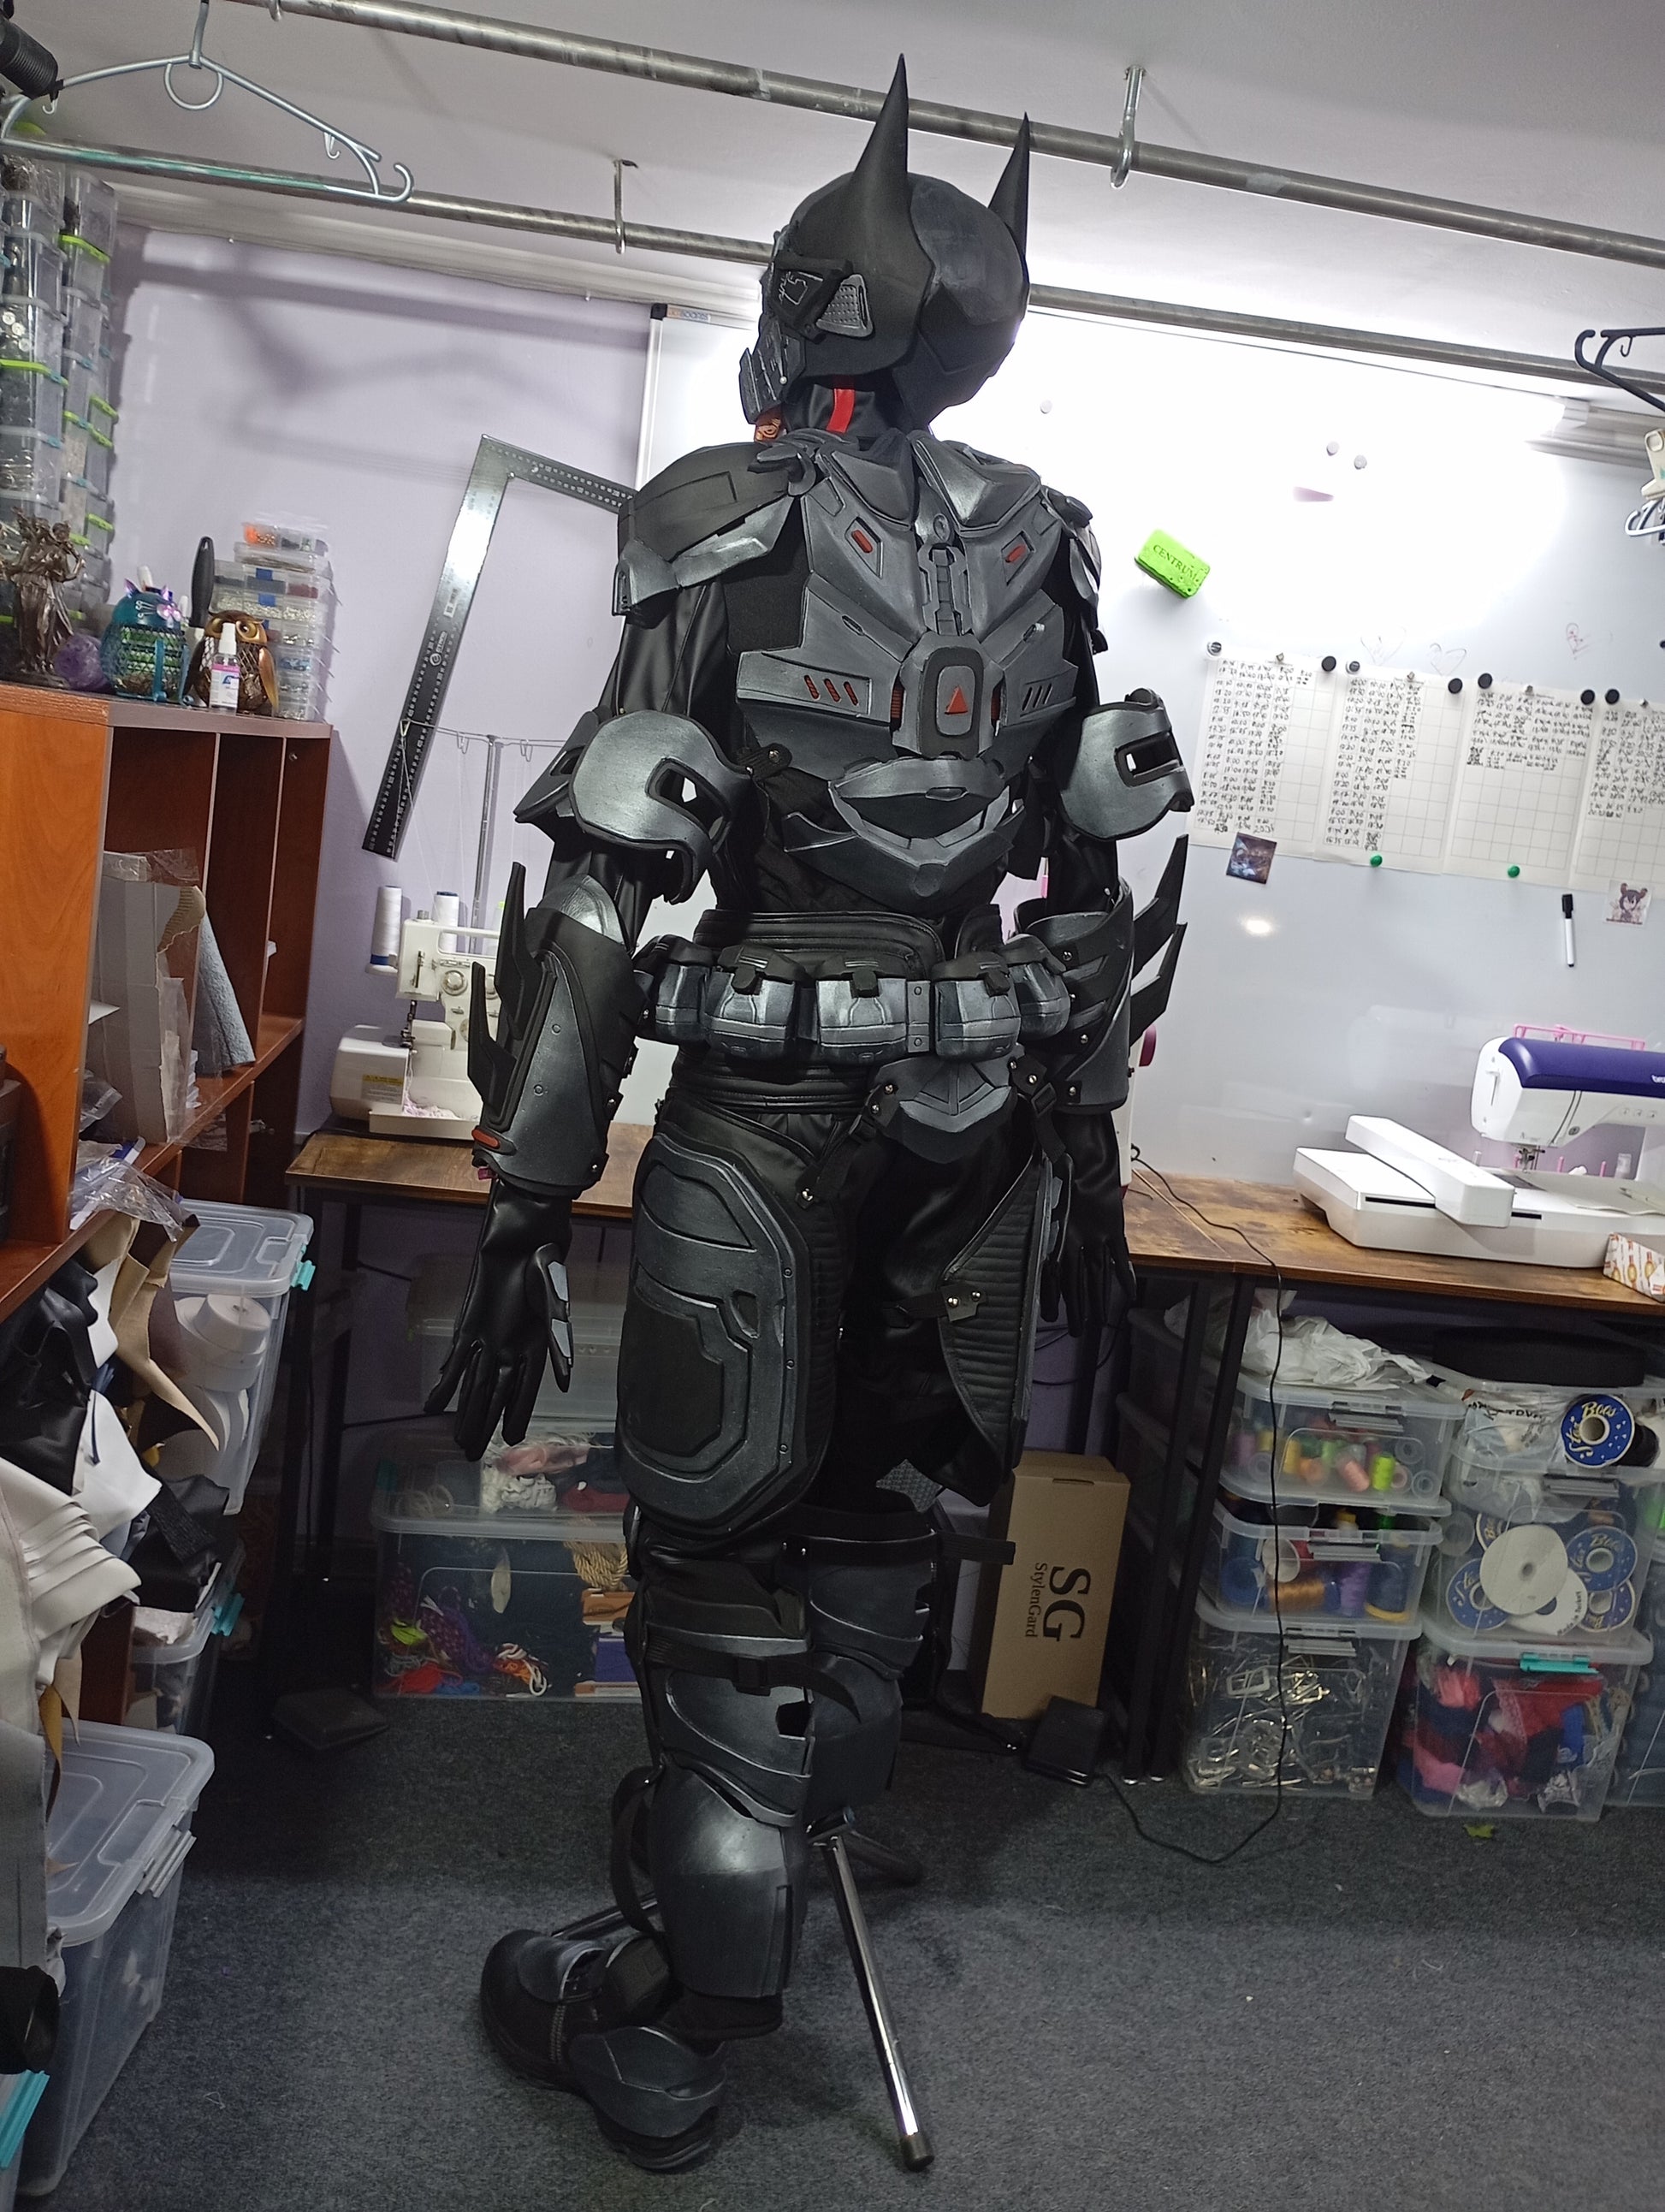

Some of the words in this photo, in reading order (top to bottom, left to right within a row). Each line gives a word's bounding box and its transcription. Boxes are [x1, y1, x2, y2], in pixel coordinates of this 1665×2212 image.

[1152, 544, 1198, 580] CENTRUM
[1024, 1562, 1048, 1638] StylenGard
[1042, 1566, 1092, 1642] SG
